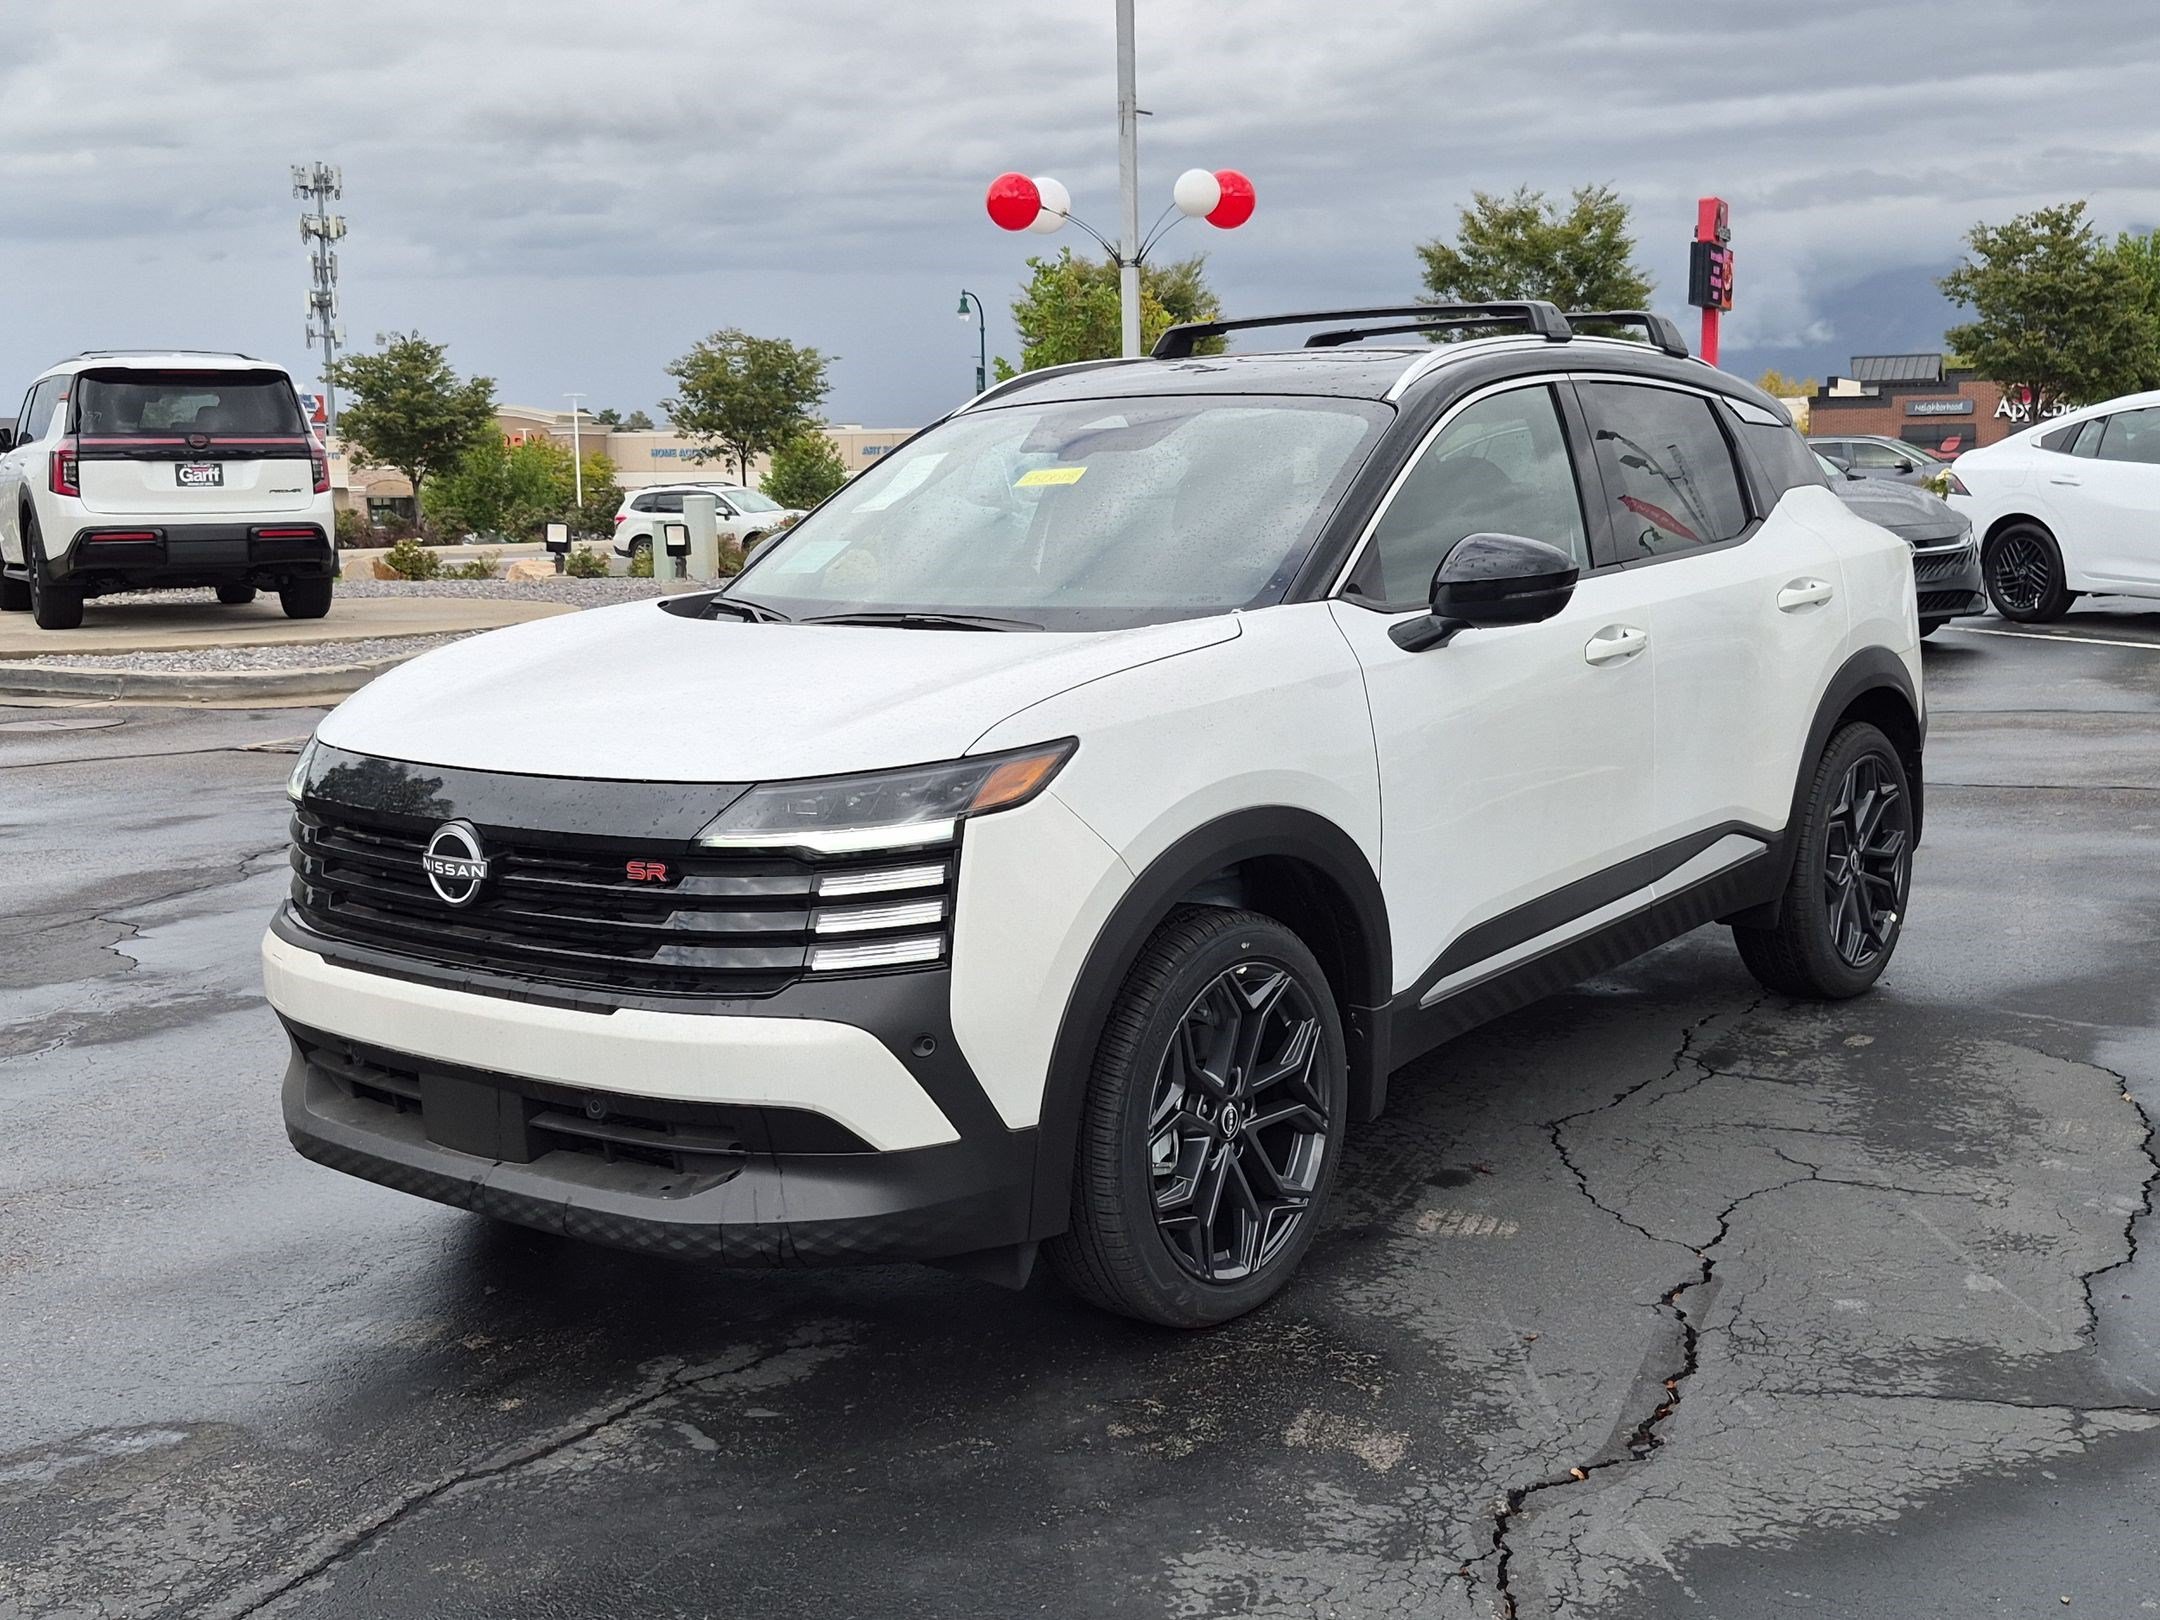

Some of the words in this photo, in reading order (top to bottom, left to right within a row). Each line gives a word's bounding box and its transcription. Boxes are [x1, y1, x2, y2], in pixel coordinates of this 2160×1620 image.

[1914, 401, 1964, 414] Neighborhood
[651, 448, 677, 458] HOME
[179, 467, 220, 482] Garff
[423, 856, 485, 878] NISSAN
[627, 861, 667, 881] SR
